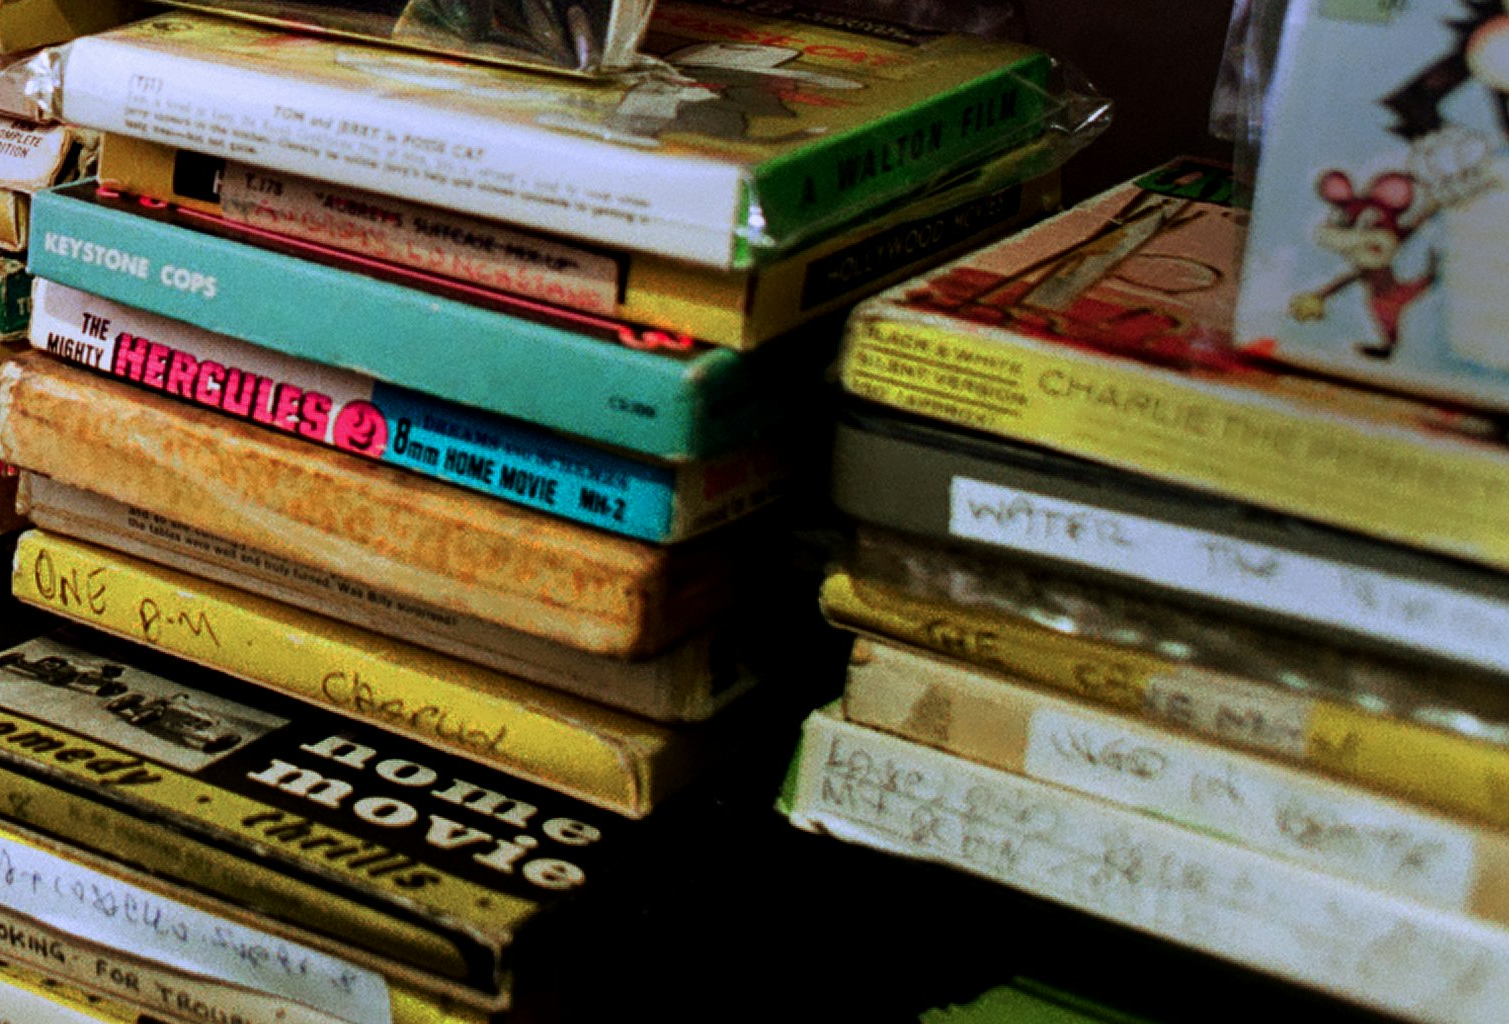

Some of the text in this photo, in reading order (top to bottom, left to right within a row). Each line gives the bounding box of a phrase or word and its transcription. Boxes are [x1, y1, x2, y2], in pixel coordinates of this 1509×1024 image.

[837, 118, 945, 193] WALTON
[960, 87, 1019, 140] FILM
[44, 231, 218, 299] KEYSTONE COPS
[826, 219, 946, 287] HOLLYWOOD
[44, 331, 106, 372] MIGHTY
[81, 311, 113, 341] THE
[112, 331, 333, 443] HERCULES
[393, 417, 440, 467] 8mm
[443, 446, 495, 485] HOME
[498, 463, 559, 505] MOVIE
[33, 547, 110, 618] ONE
[242, 811, 443, 893] thrills
[249, 758, 587, 891] movie
[95, 958, 140, 992] FOR
